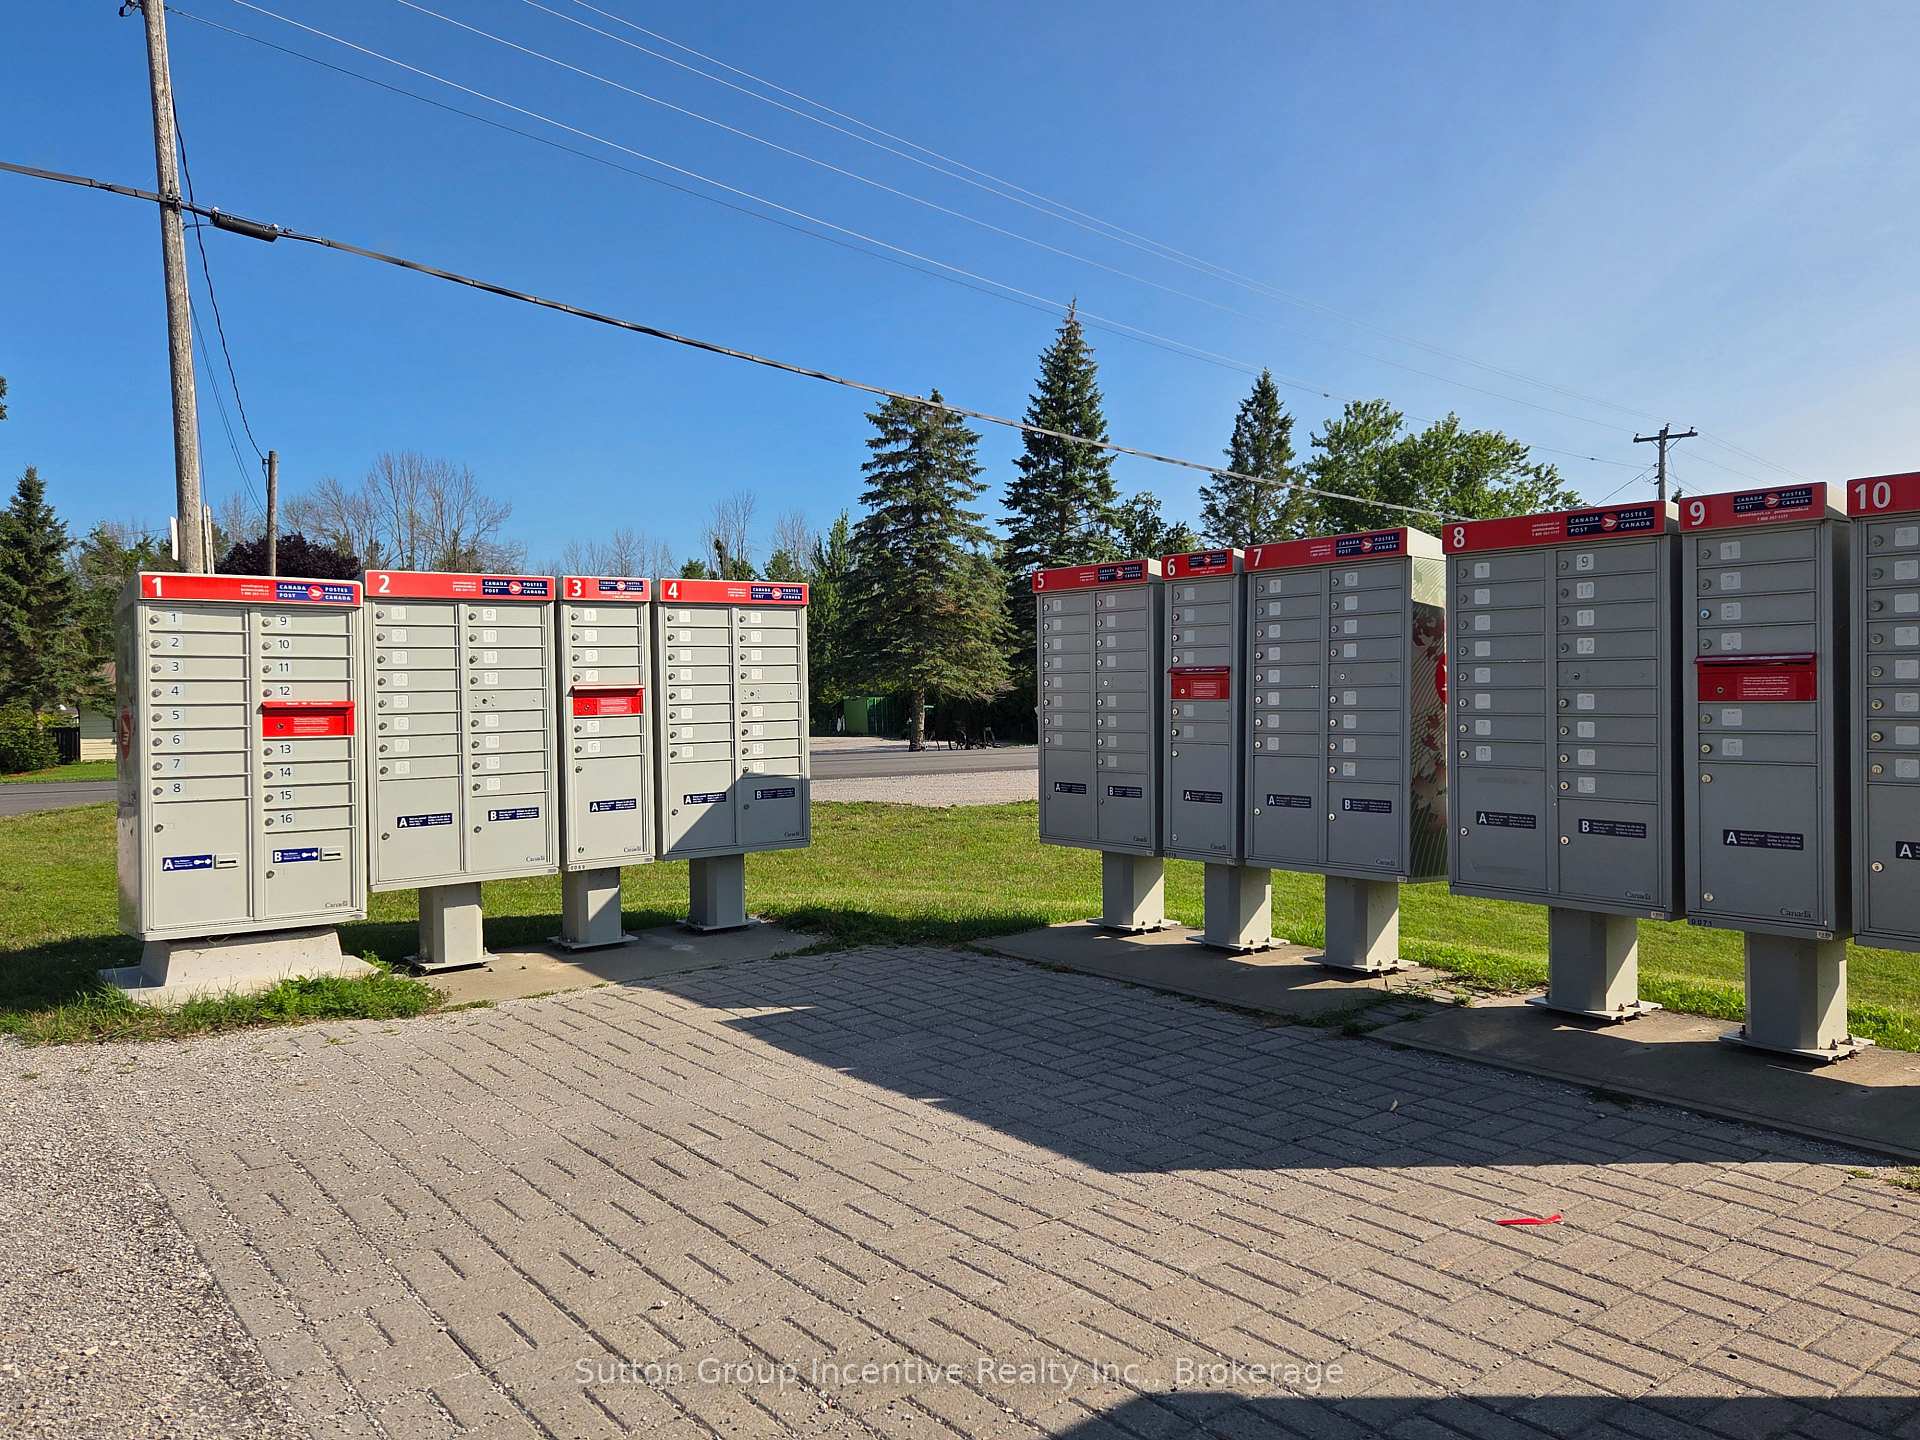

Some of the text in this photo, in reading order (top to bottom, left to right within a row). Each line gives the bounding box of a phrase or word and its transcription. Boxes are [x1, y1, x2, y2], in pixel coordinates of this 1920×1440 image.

[1737, 495, 1763, 503] CANADA
[1855, 482, 1891, 510] 10
[1782, 498, 1808, 506] CANADA
[1690, 501, 1706, 526] 9
[1570, 516, 1599, 524] CANADA
[1620, 521, 1650, 529] CANADA
[1453, 527, 1465, 548] 8
[1253, 548, 1263, 567] 7
[1581, 556, 1588, 568] 9
[1168, 558, 1176, 576] 6
[378, 575, 391, 594] 2
[1038, 572, 1045, 589] 5
[152, 578, 162, 596] 1
[324, 586, 348, 594] POSTES
[572, 580, 582, 597] 3
[668, 582, 679, 598] 4
[171, 614, 176, 623] 1
[280, 616, 287, 626] 9
[171, 638, 179, 647] 2
[279, 640, 290, 649] 10
[172, 662, 179, 672] 3
[279, 663, 289, 672] 11
[171, 686, 179, 696] 4
[280, 686, 290, 696] 12
[172, 710, 180, 720] 5
[173, 735, 180, 744] 6
[280, 744, 291, 754] 13
[173, 759, 180, 768] 7
[280, 768, 291, 777] 14
[174, 784, 180, 793] 8
[1056, 783, 1061, 792] A
[1109, 787, 1114, 796] B
[280, 791, 292, 800] 15
[684, 795, 692, 804] A
[756, 790, 762, 800] B
[1184, 792, 1192, 801] A
[1268, 795, 1276, 806] A
[1344, 800, 1351, 810] B
[591, 802, 599, 812] A
[281, 814, 292, 824] 16
[490, 811, 497, 820] B
[1479, 812, 1488, 824] A
[400, 818, 408, 828] A
[1582, 820, 1590, 832] B
[1726, 831, 1738, 844] A
[1900, 843, 1912, 858] A
[274, 852, 282, 862] B
[163, 859, 174, 870] A
